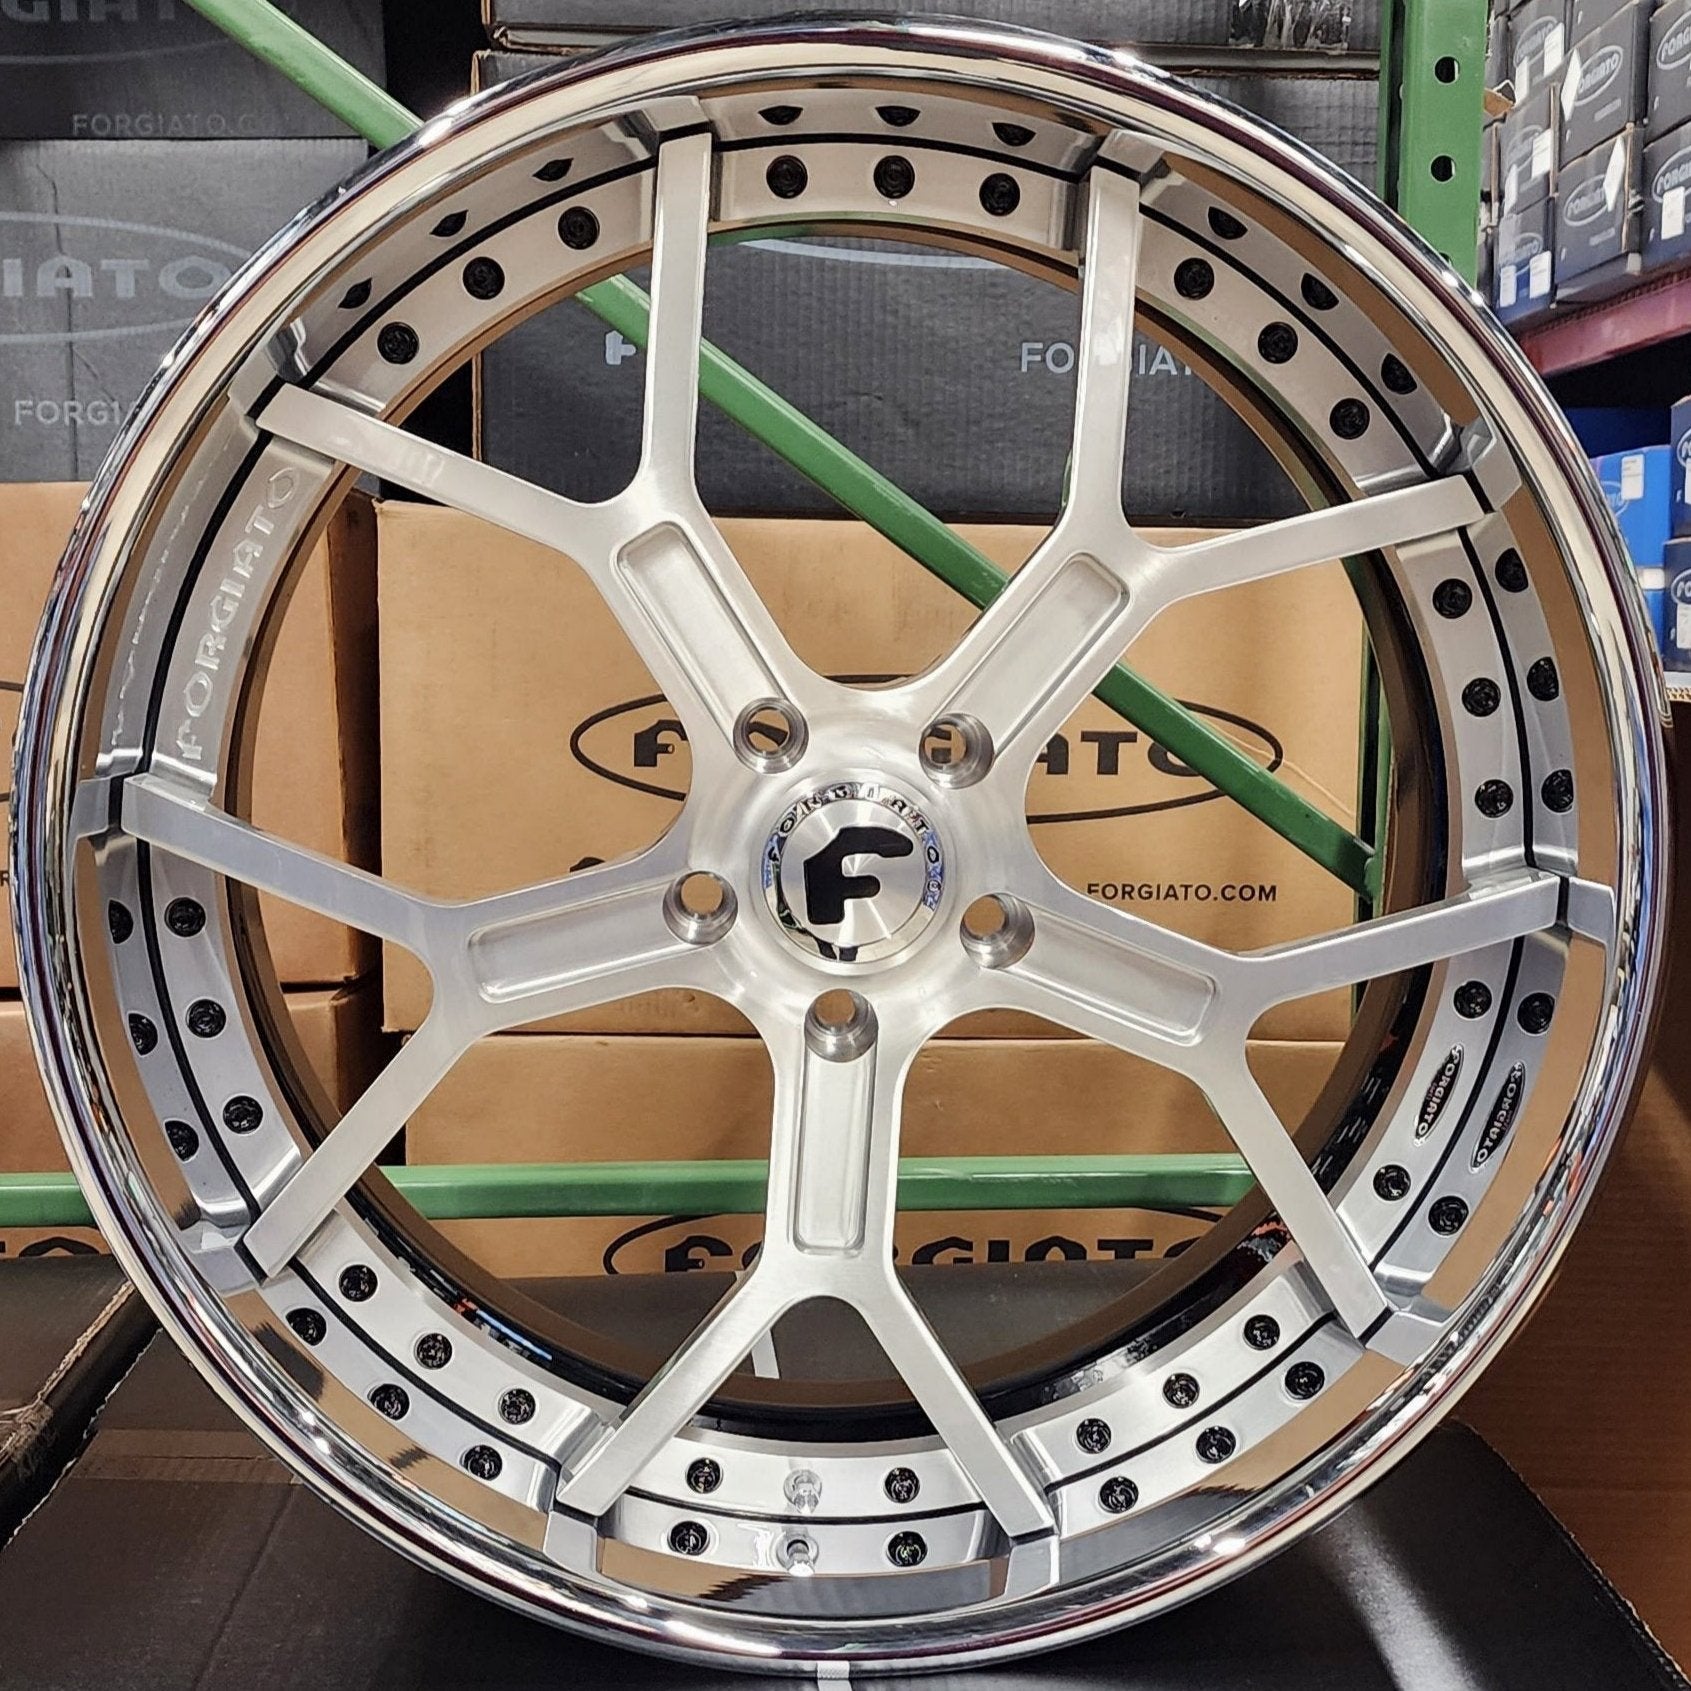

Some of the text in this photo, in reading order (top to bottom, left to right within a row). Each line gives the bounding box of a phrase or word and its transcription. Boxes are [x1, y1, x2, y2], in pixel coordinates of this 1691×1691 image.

[14, 400, 126, 426] FORGI
[176, 467, 298, 760] FORGIATO
[1087, 883, 1277, 901] FORGIATO.COM
